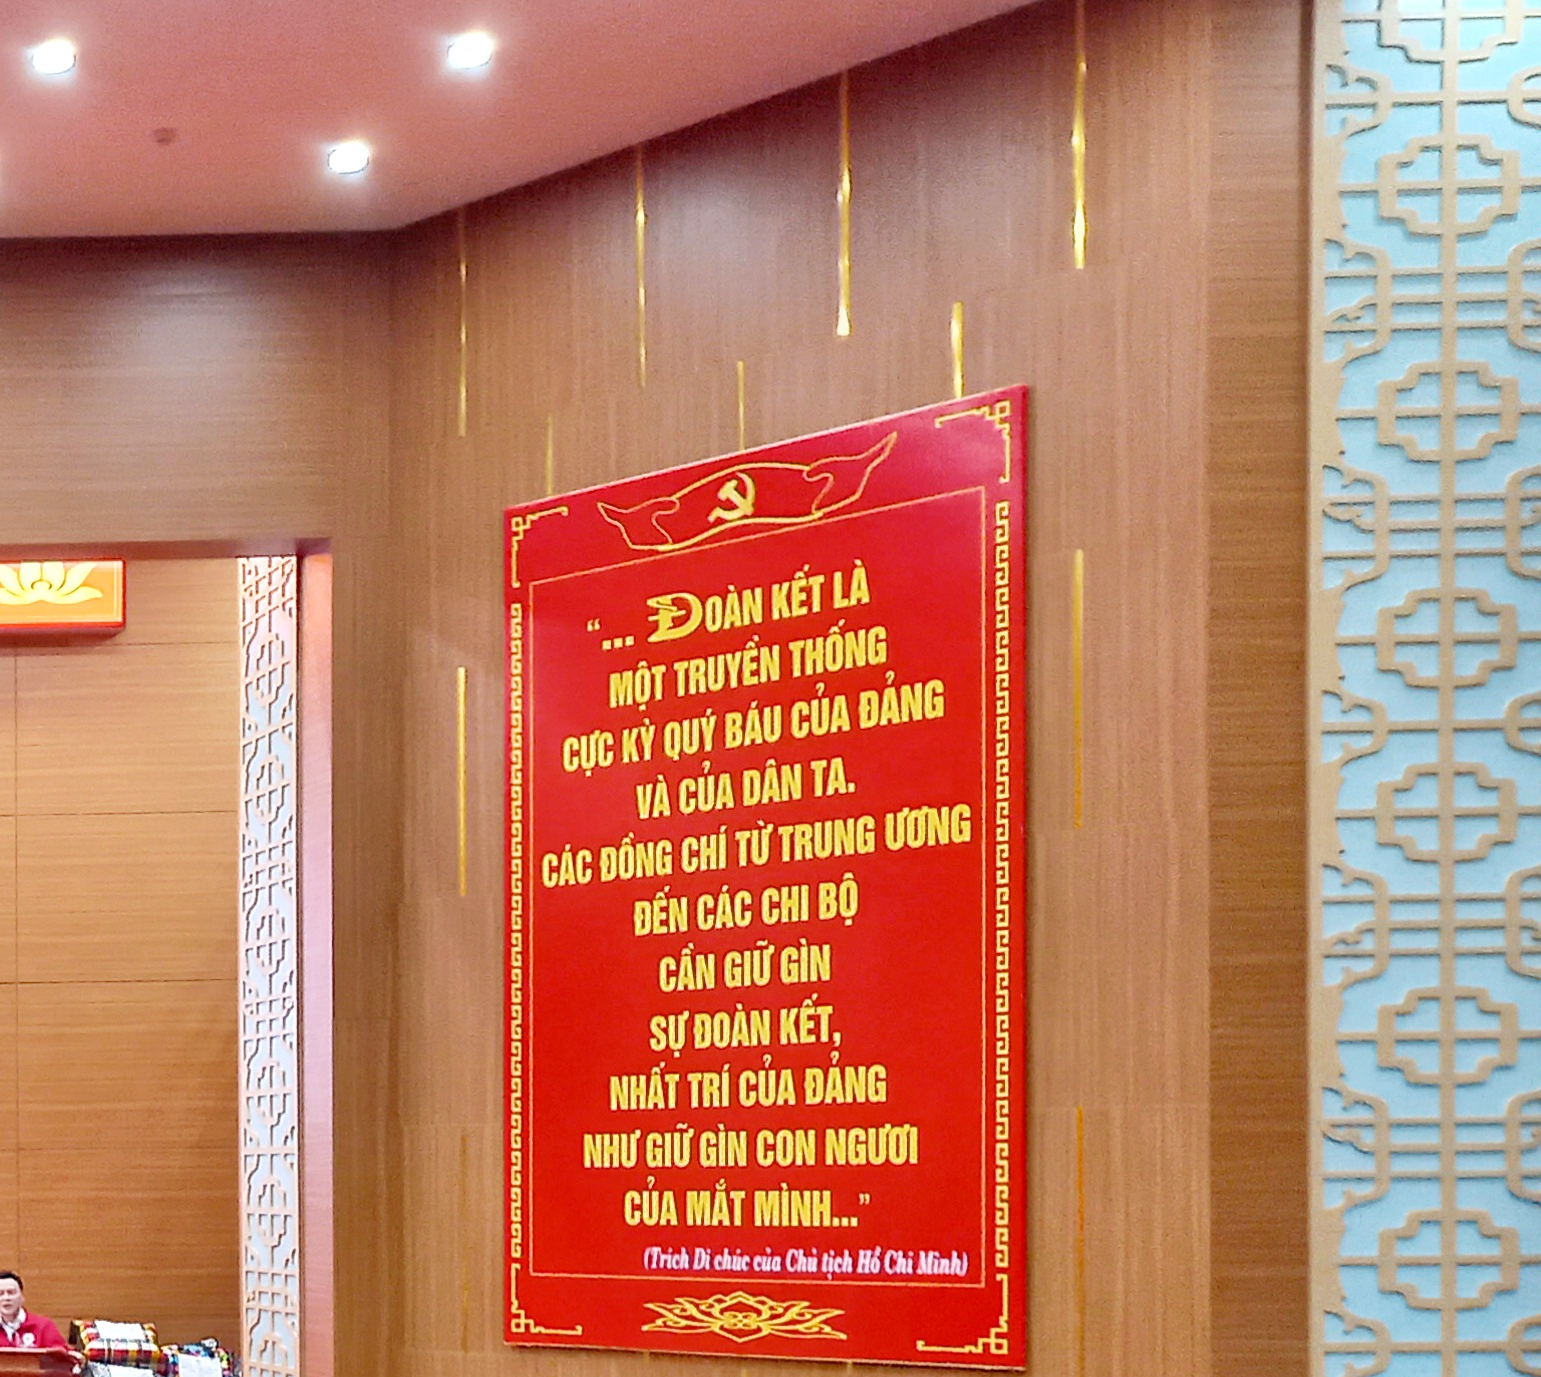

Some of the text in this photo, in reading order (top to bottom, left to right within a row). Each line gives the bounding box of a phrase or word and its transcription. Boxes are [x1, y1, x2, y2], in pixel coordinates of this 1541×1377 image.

[646, 559, 870, 643] ĐOÀN KẾT LÀ
[609, 618, 887, 712] MỘT TRUYỀN THỐNG
[562, 670, 945, 777] CỰC KỲ QUÝ BÁU CỦA ĐẢNG
[636, 757, 856, 820] VÀ CỦA DÂN TA.
[541, 803, 972, 888] CÁC ĐỒNG CHÍ TỪ TRUNG ƯƠNG
[633, 872, 859, 937] ĐẾN CÁC CHI BỘ
[659, 937, 831, 993] CẦN GIỮ GÌN
[649, 992, 841, 1058] SỰ ĐOÀN KẾT,
[609, 1050, 887, 1111] NHẤT TRÍ CỦA ĐẢNG
[583, 1129, 642, 1169] NHƯ
[645, 1122, 695, 1168] GIỮ
[699, 1123, 747, 1168] GÌN
[756, 1129, 816, 1167] CON
[624, 1175, 678, 1226] CỦA
[686, 1178, 746, 1227] MẮT
